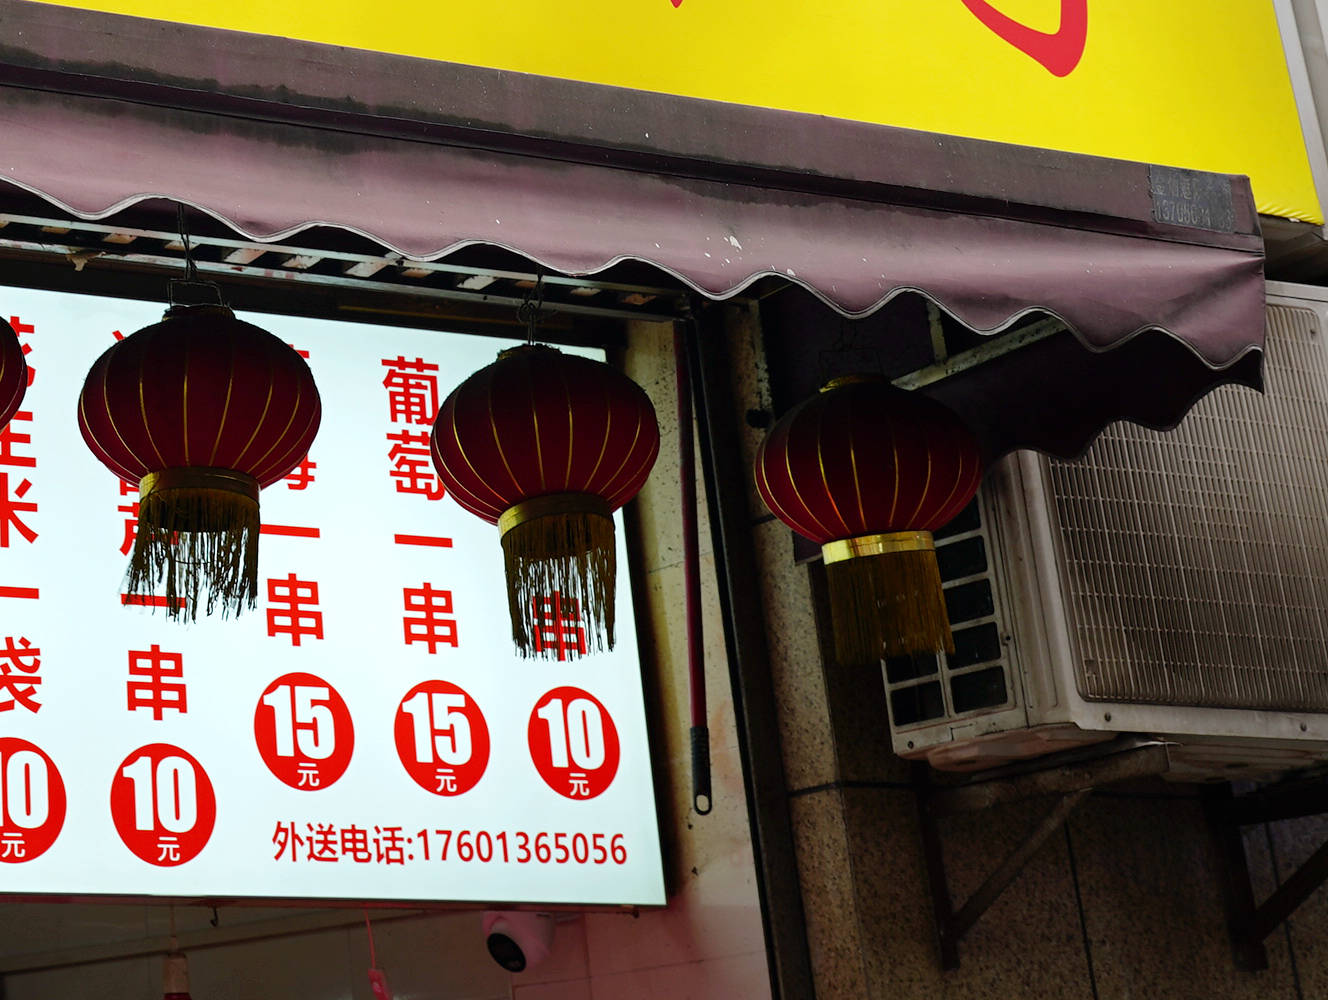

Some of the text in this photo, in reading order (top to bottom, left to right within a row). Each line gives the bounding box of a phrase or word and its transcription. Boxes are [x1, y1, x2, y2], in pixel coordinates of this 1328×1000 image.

[381, 355, 459, 655] 葡萄一串
[263, 684, 336, 760] 15
[401, 691, 472, 766] 15
[537, 697, 605, 771] 10
[122, 756, 197, 834] 10
[296, 763, 321, 788] 元
[435, 769, 458, 794] 元
[568, 772, 591, 798] 元
[1, 832, 26, 859] 元
[157, 837, 181, 862] 元
[272, 821, 628, 866] 外送电话:17601365056
